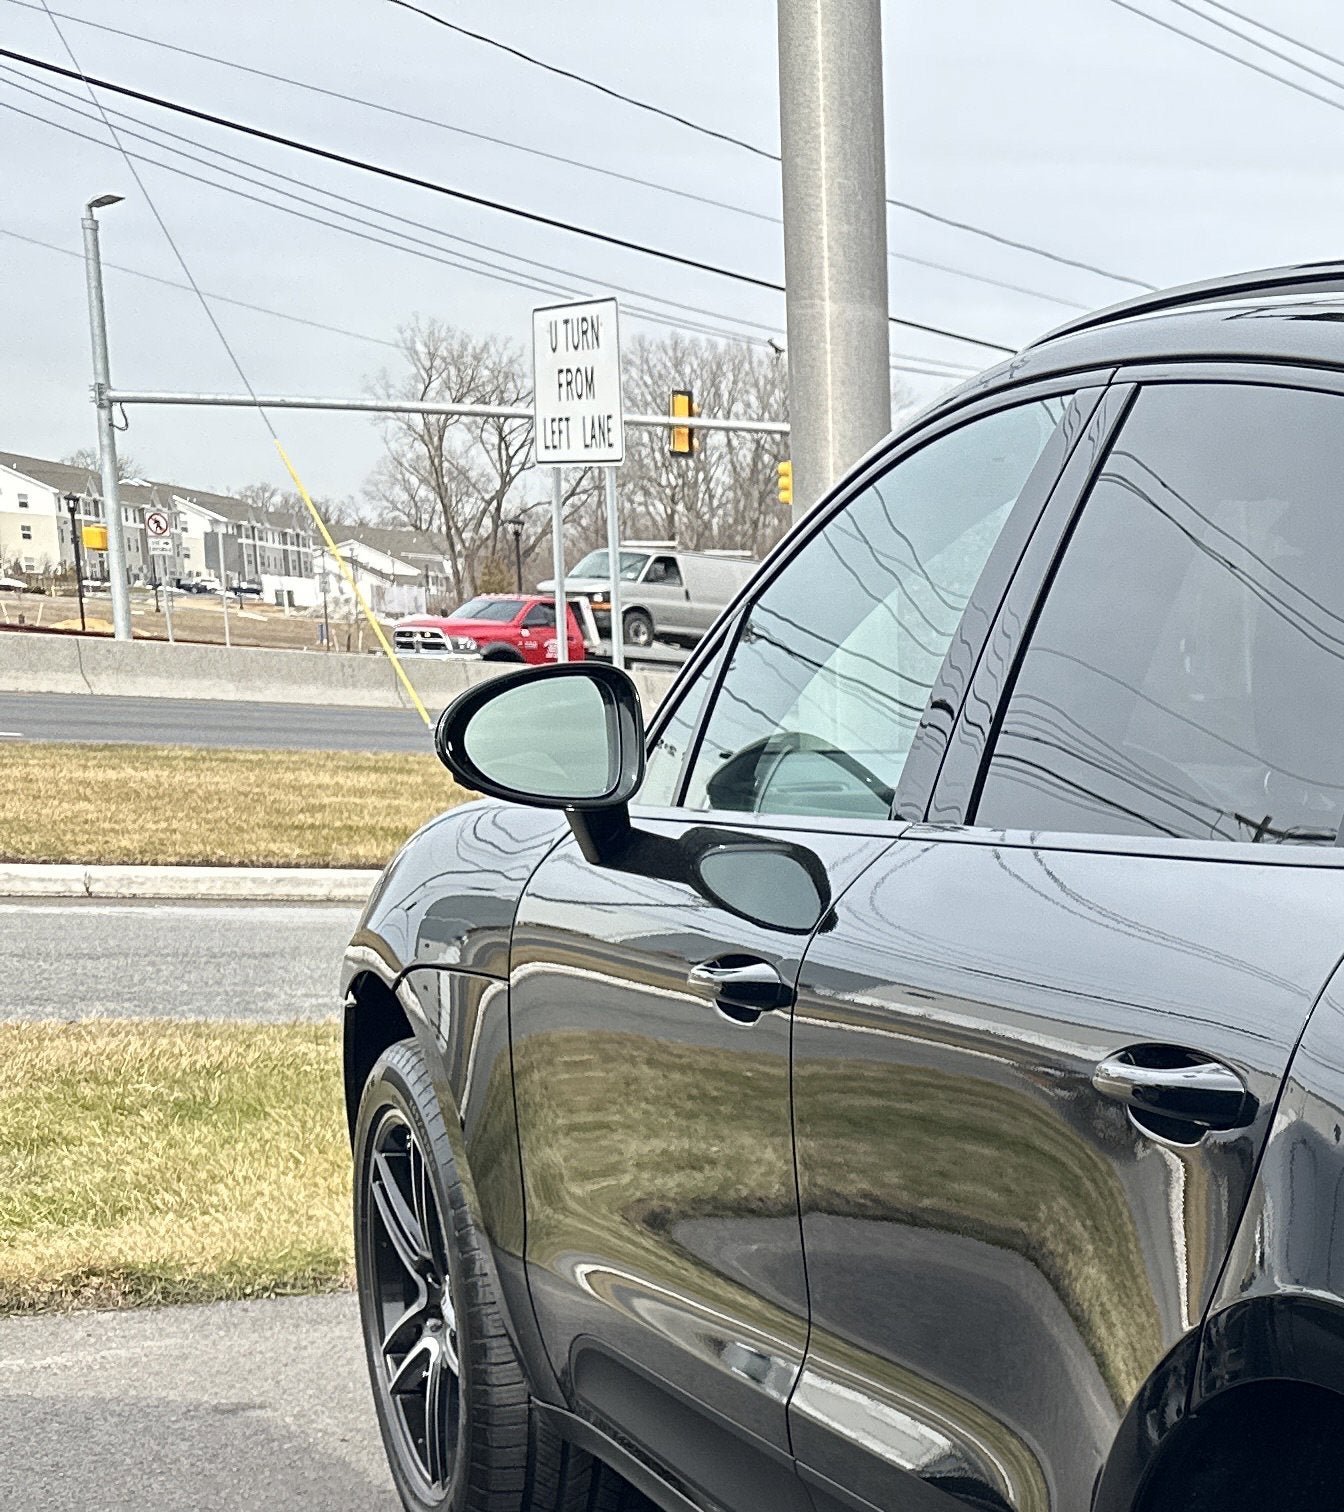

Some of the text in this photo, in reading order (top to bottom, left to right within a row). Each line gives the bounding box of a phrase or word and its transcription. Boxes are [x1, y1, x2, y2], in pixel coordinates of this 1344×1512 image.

[550, 314, 600, 353] U TURN
[557, 365, 596, 401] FROM
[543, 413, 614, 450] LEFT LANE
